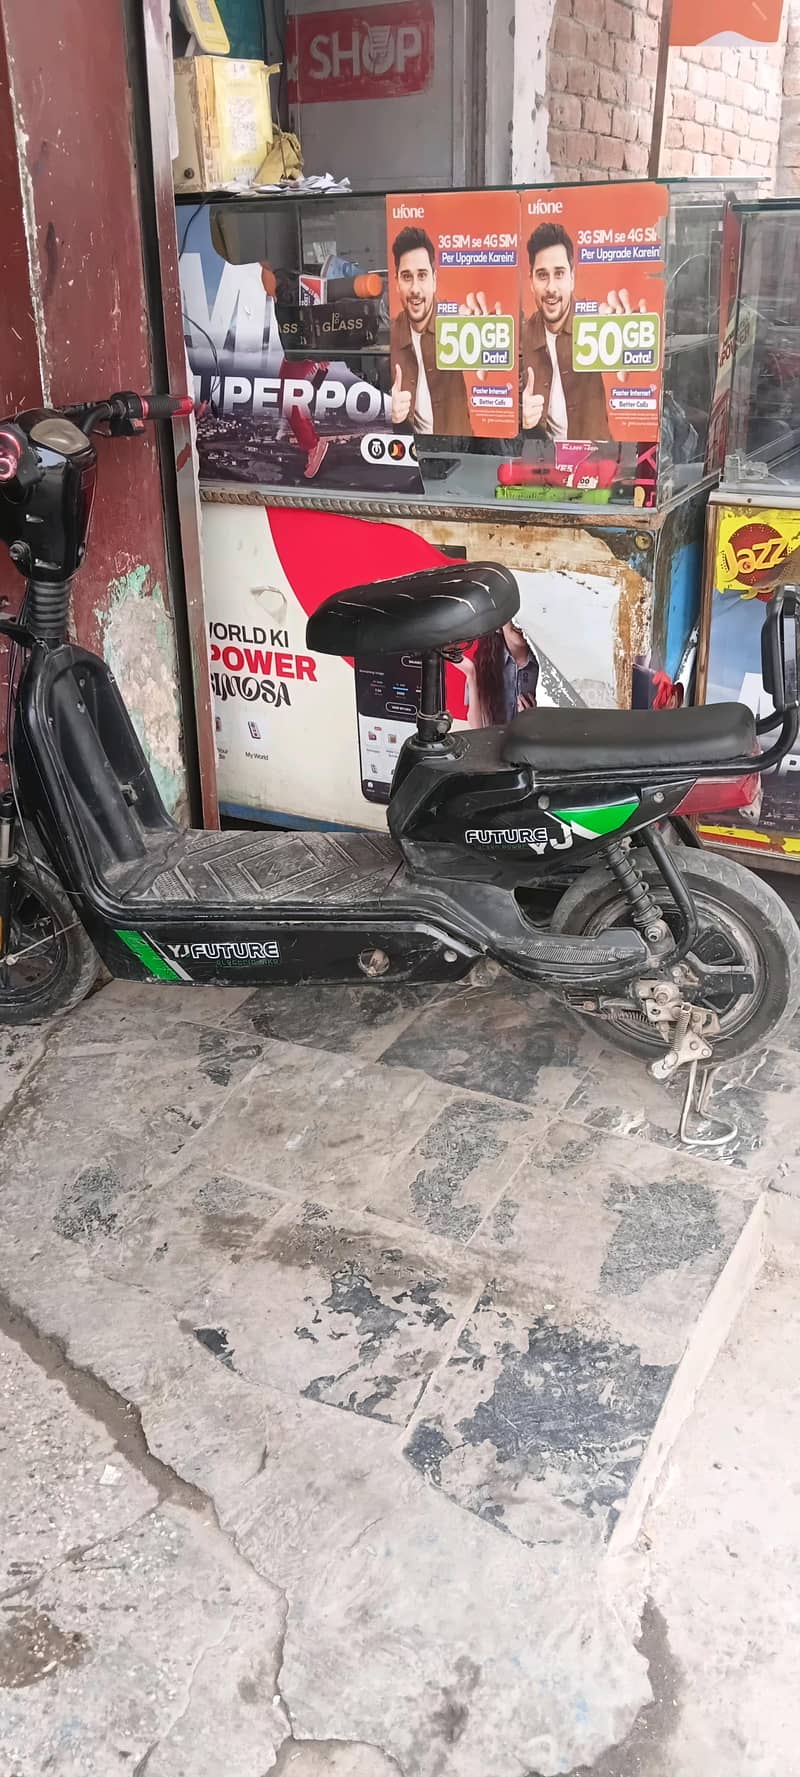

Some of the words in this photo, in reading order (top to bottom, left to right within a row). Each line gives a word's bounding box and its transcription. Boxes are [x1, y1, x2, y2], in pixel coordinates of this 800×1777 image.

[309, 26, 423, 80] SHOP
[392, 204, 425, 219] ufone
[527, 199, 563, 215] ufone
[438, 236, 451, 248] 3G
[452, 235, 470, 248] SIM
[471, 239, 482, 247] se
[483, 235, 497, 247] 4G
[499, 234, 518, 247] SIM
[577, 230, 592, 244] 3G
[593, 230, 613, 243] SIM
[615, 234, 626, 243] se
[627, 229, 643, 242] 4G
[442, 252, 454, 263] Per
[456, 252, 487, 265] Upgrade
[488, 251, 514, 262] Karein!
[581, 249, 595, 260] Per
[596, 247, 632, 261] Upgrade
[437, 303, 458, 313] FREE
[575, 302, 598, 312] FREE
[322, 312, 363, 332] GLASS
[482, 352, 508, 364] Data!
[623, 350, 653, 364] Data!
[720, 537, 788, 581] Jazz
[209, 622, 267, 645] ORLD
[270, 629, 289, 648] KI
[465, 828, 548, 844] FUTURE
[191, 941, 280, 959] FUTURE
